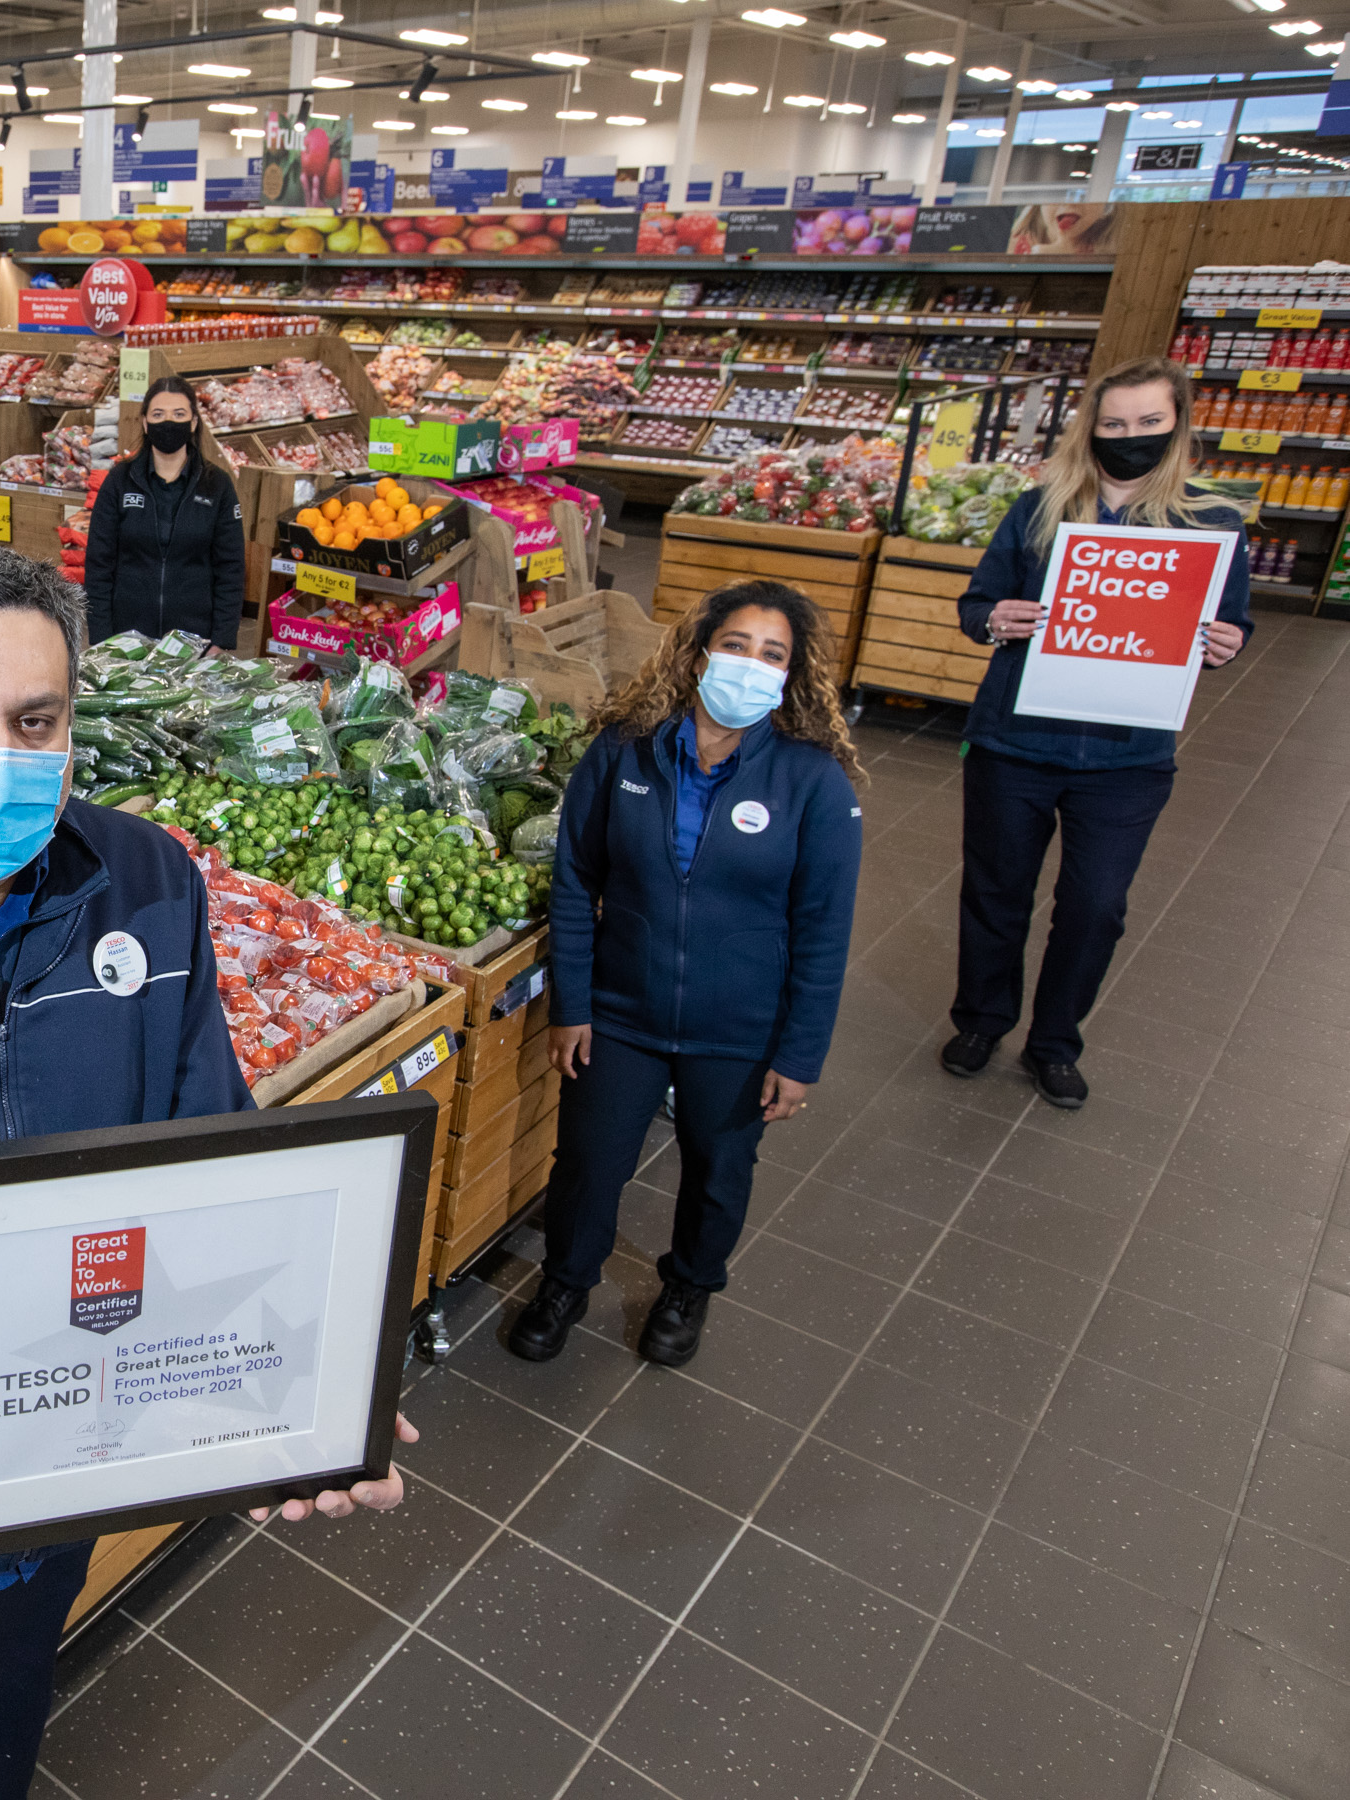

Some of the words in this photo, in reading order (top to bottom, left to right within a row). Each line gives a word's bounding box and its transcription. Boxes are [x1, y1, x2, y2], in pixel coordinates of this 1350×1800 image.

[268, 121, 307, 150] Fruit
[432, 151, 444, 168] 6
[544, 160, 554, 175] 7
[92, 268, 125, 285] Best
[88, 288, 128, 305] Value
[94, 308, 120, 329] You
[1262, 312, 1288, 321] Great
[1290, 313, 1317, 322] Value
[123, 372, 147, 382] €6.29
[1260, 373, 1281, 384] €3
[936, 430, 965, 449] 49c
[1241, 435, 1262, 446] €3
[378, 444, 393, 454] 55c
[418, 452, 450, 467] ZANI
[124, 496, 145, 507] F&F
[421, 528, 456, 560] JOYEN
[309, 550, 370, 574] JOYEN
[1071, 540, 1180, 572] Great
[282, 564, 295, 573] 55c
[302, 570, 316, 583] Any
[318, 574, 324, 583] 5
[325, 576, 337, 587] for
[339, 580, 350, 590] €2
[1066, 569, 1170, 600] Place
[1060, 597, 1098, 623] To
[278, 623, 310, 642] Pink
[310, 633, 342, 651] Lady
[277, 645, 290, 654] 55c
[622, 779, 650, 792] TESCO
[105, 936, 126, 947] TESCO
[108, 946, 128, 957] Hassan
[434, 1039, 445, 1050] Save
[416, 1050, 436, 1071] 89c
[382, 1077, 394, 1088] Save
[76, 1234, 129, 1252] Great
[77, 1251, 128, 1267] Place
[76, 1267, 95, 1281] To
[76, 1295, 138, 1313] Certified
[79, 1314, 95, 1322] NOV
[91, 1320, 120, 1329] IRELAND
[116, 1346, 129, 1357] Is
[133, 1334, 204, 1355] Certified
[208, 1335, 226, 1345] as
[229, 1332, 238, 1342] a
[115, 1357, 162, 1374] Great
[166, 1352, 209, 1368] Place
[213, 1348, 230, 1360] to
[234, 1340, 276, 1356] Work
[0, 1364, 92, 1392] TESCO
[115, 1375, 155, 1390] From
[160, 1363, 242, 1385] November
[245, 1356, 283, 1372] 2020
[114, 1394, 135, 1407] To
[139, 1385, 205, 1404] October
[208, 1378, 243, 1394] 2021
[191, 1436, 215, 1448] THE
[218, 1430, 251, 1443] IRISH
[254, 1424, 291, 1437] TIMES
[77, 1443, 99, 1453] Cathal
[101, 1441, 123, 1452] Divilly
[90, 1450, 108, 1458] CEO
[71, 1460, 88, 1468] Place
[120, 1452, 146, 1461] Institute
